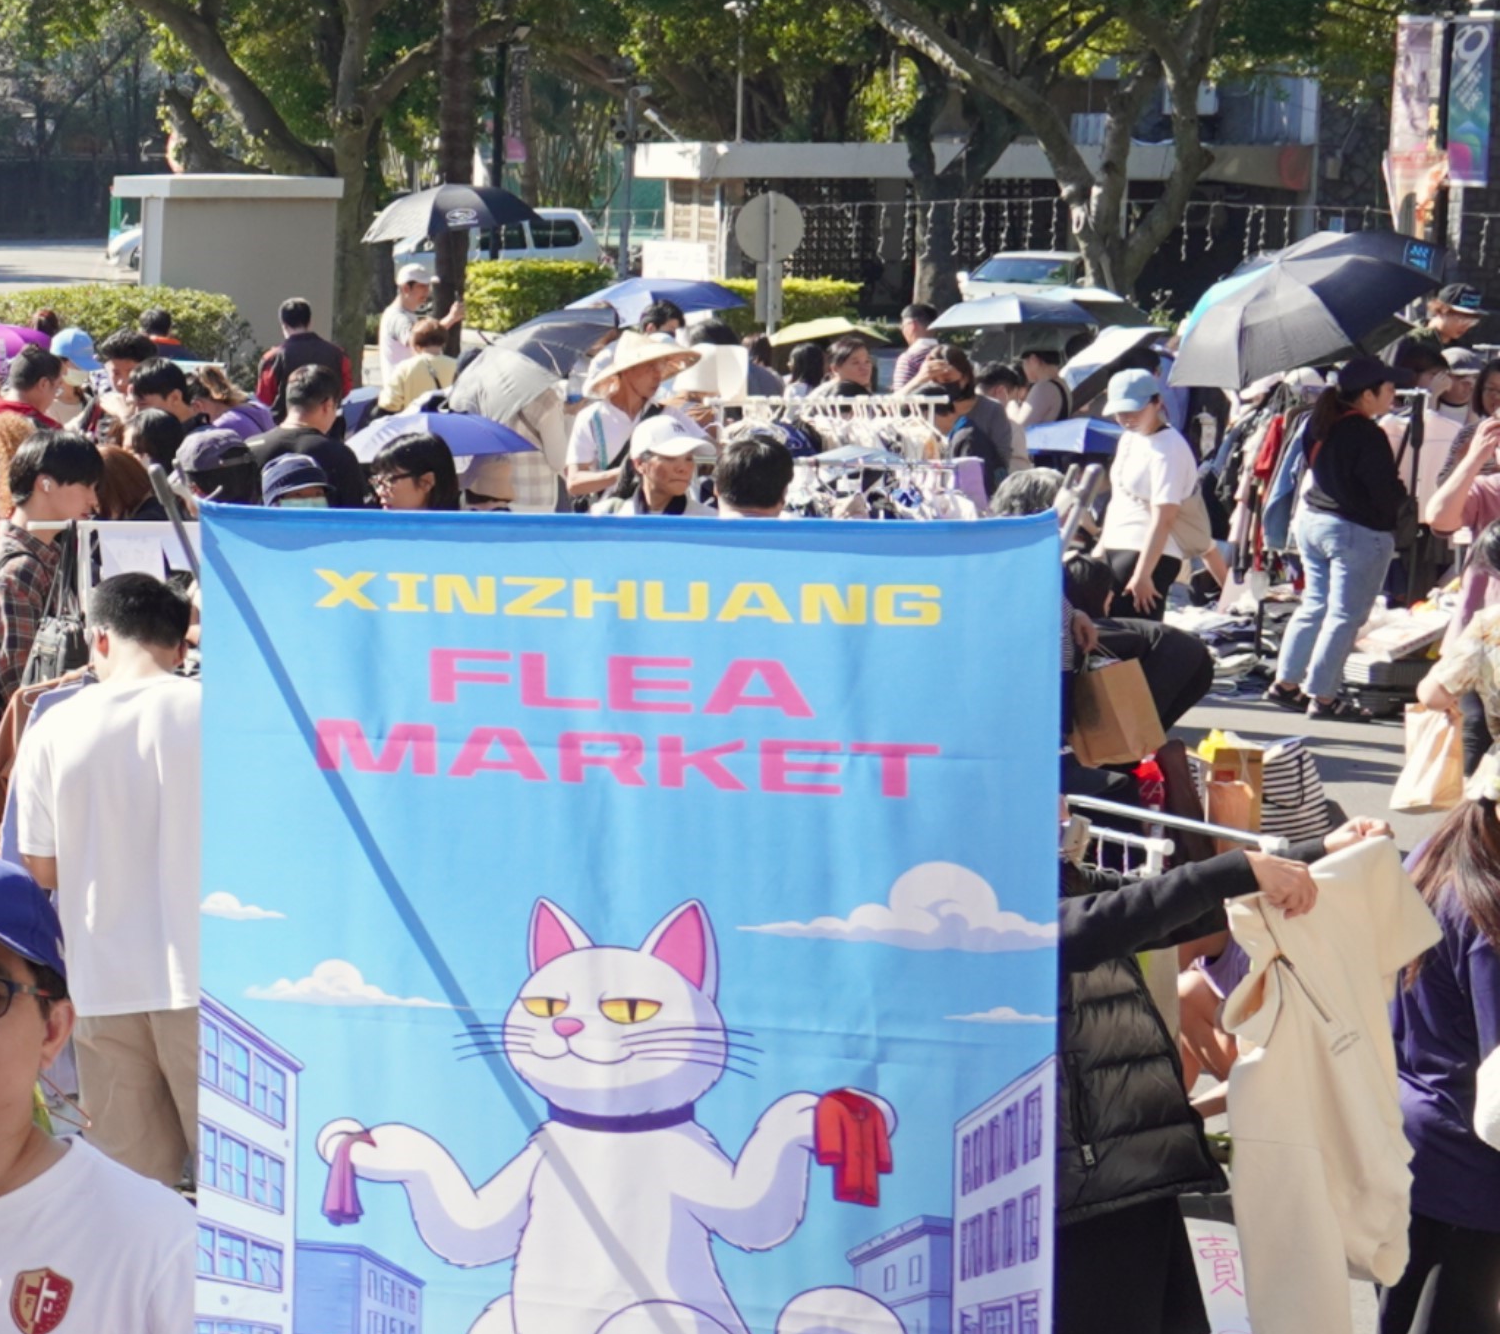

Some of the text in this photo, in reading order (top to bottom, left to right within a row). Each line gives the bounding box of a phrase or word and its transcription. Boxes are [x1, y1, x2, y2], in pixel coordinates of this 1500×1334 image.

[313, 568, 942, 626] XINZHUANG
[429, 648, 816, 719] FLEA
[316, 718, 942, 798] MARKET
